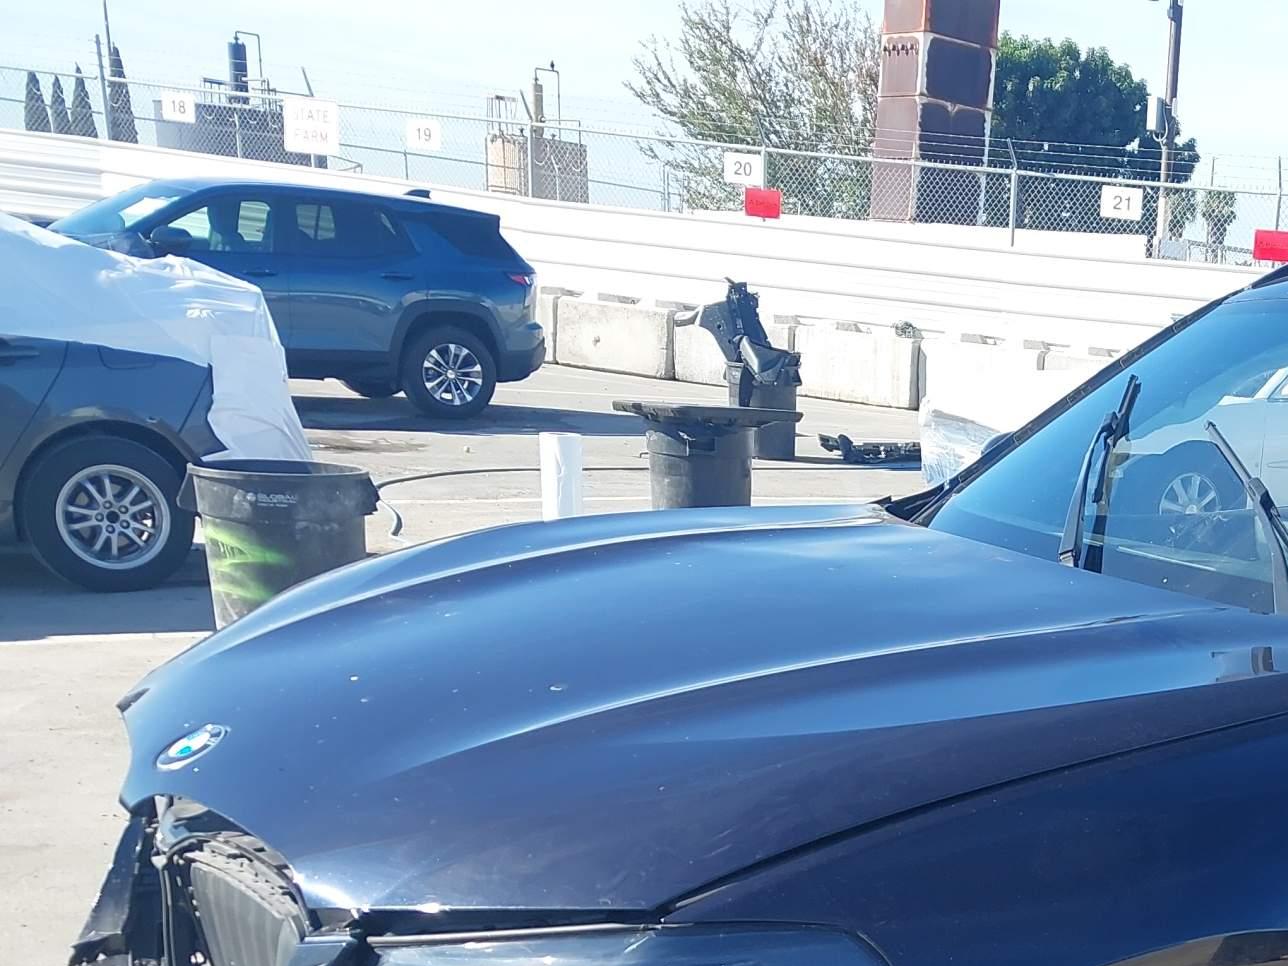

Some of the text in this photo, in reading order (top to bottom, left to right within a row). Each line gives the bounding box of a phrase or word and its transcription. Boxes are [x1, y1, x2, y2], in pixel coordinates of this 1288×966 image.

[172, 100, 186, 114] 18
[295, 129, 328, 145] FARM
[416, 128, 431, 141] 19
[733, 161, 752, 177] 20
[1112, 195, 1131, 211] 21
